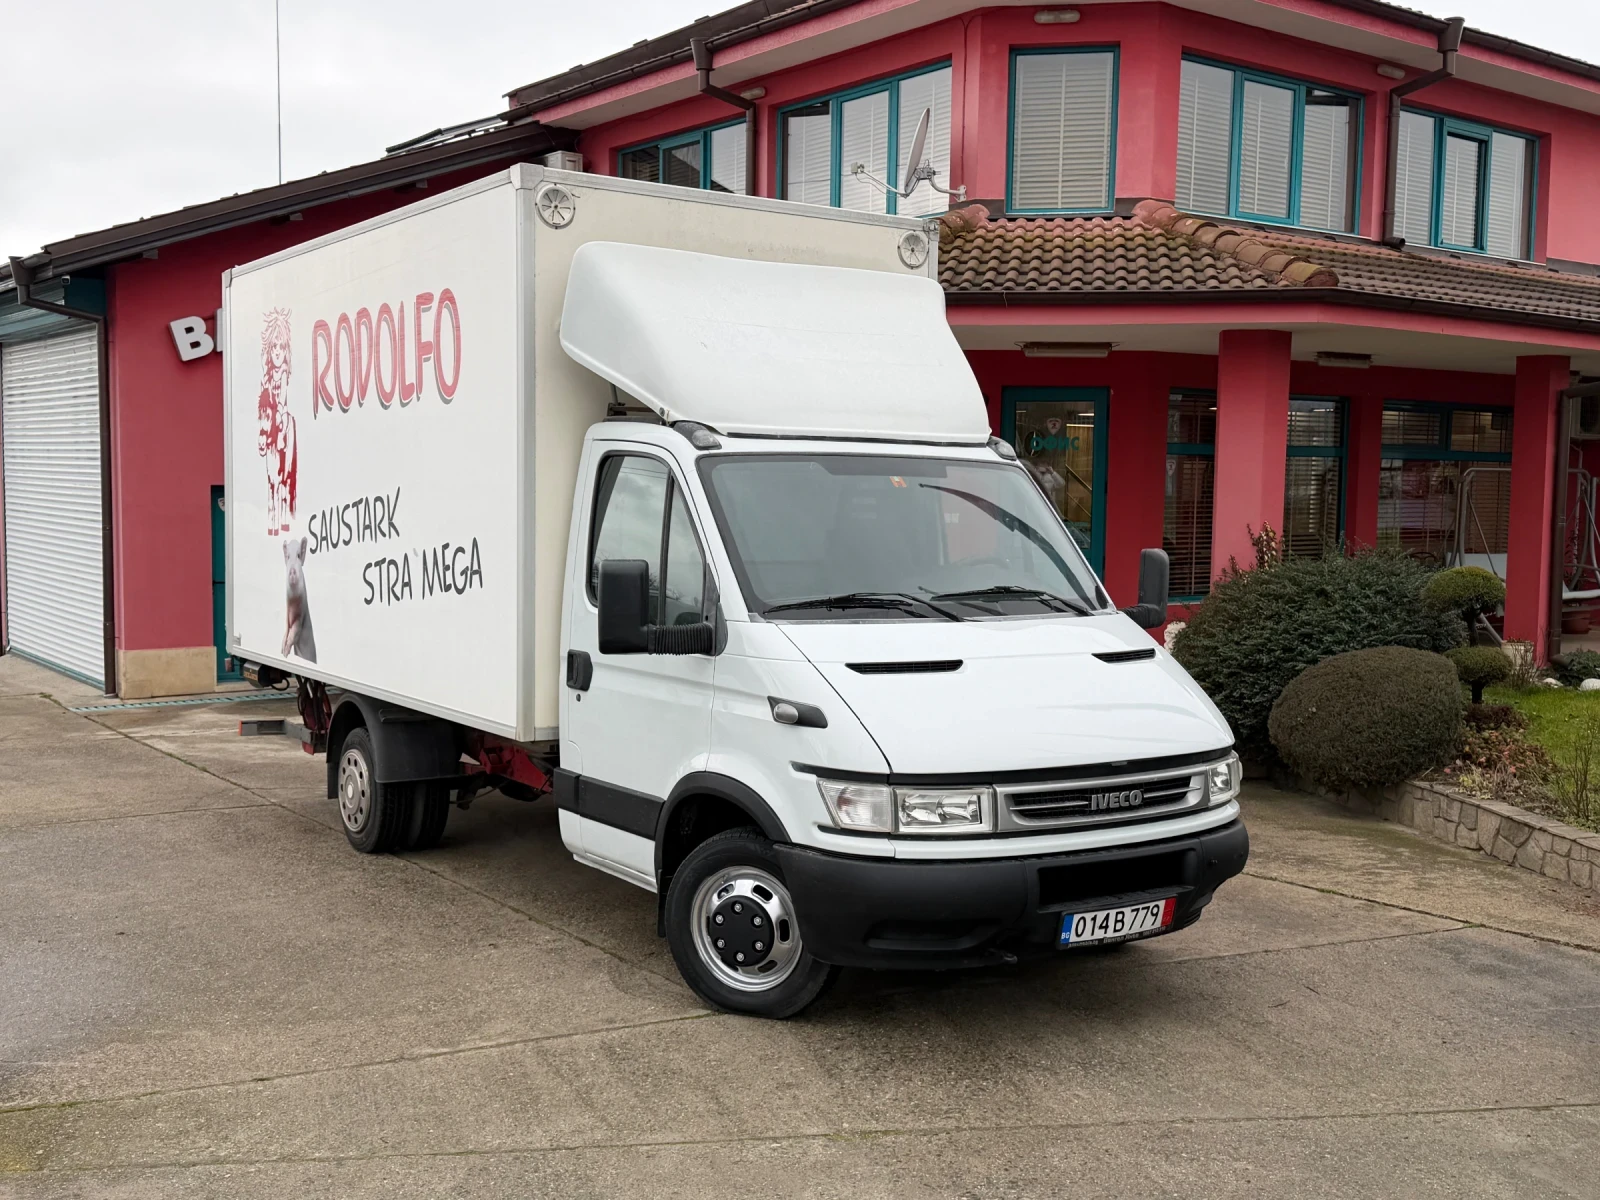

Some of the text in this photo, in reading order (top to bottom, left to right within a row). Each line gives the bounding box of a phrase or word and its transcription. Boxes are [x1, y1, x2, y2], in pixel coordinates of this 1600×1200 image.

[312, 288, 462, 420] RODOLFO
[308, 486, 401, 555] SAUSTARK
[363, 537, 483, 606] STRA MEGA
[1091, 789, 1143, 811] IVECO
